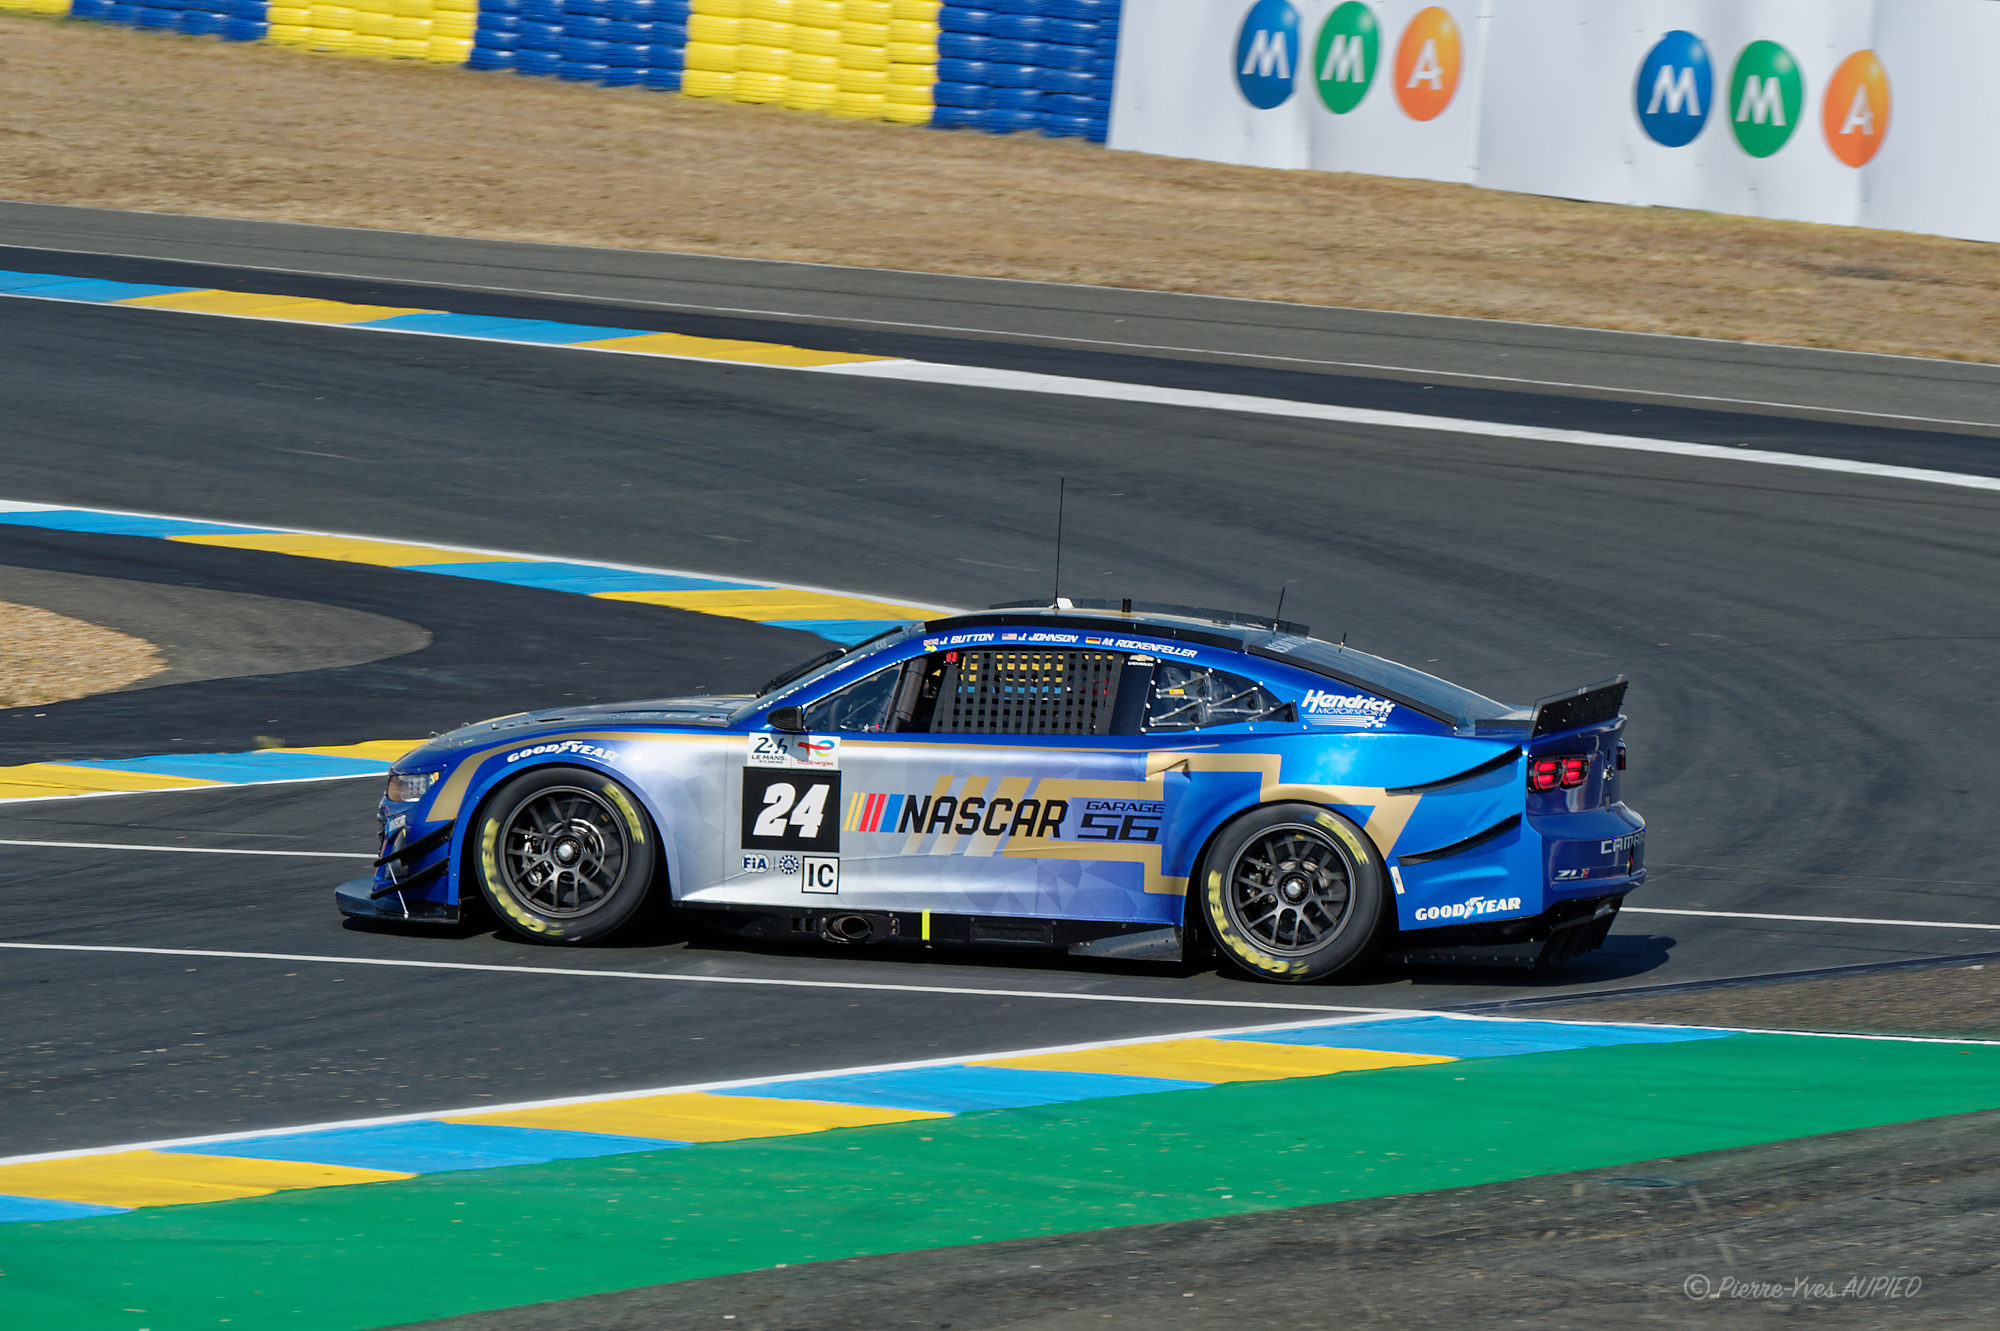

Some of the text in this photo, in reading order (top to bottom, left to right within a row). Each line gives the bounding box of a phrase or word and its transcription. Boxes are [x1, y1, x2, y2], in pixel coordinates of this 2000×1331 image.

[950, 633, 994, 644] BUTTON
[1028, 634, 1079, 643] JOHNSON
[1115, 639, 1198, 658] ROCKENFELLER
[1301, 689, 1396, 713] Hendrick
[507, 741, 619, 763] GOODYEAR
[752, 782, 831, 838] 24
[899, 795, 1069, 839] NASCAR
[1086, 801, 1166, 814] GARAGE
[1077, 814, 1160, 842] 56
[808, 863, 834, 888] IC
[1415, 896, 1521, 921] GOODYEAR
